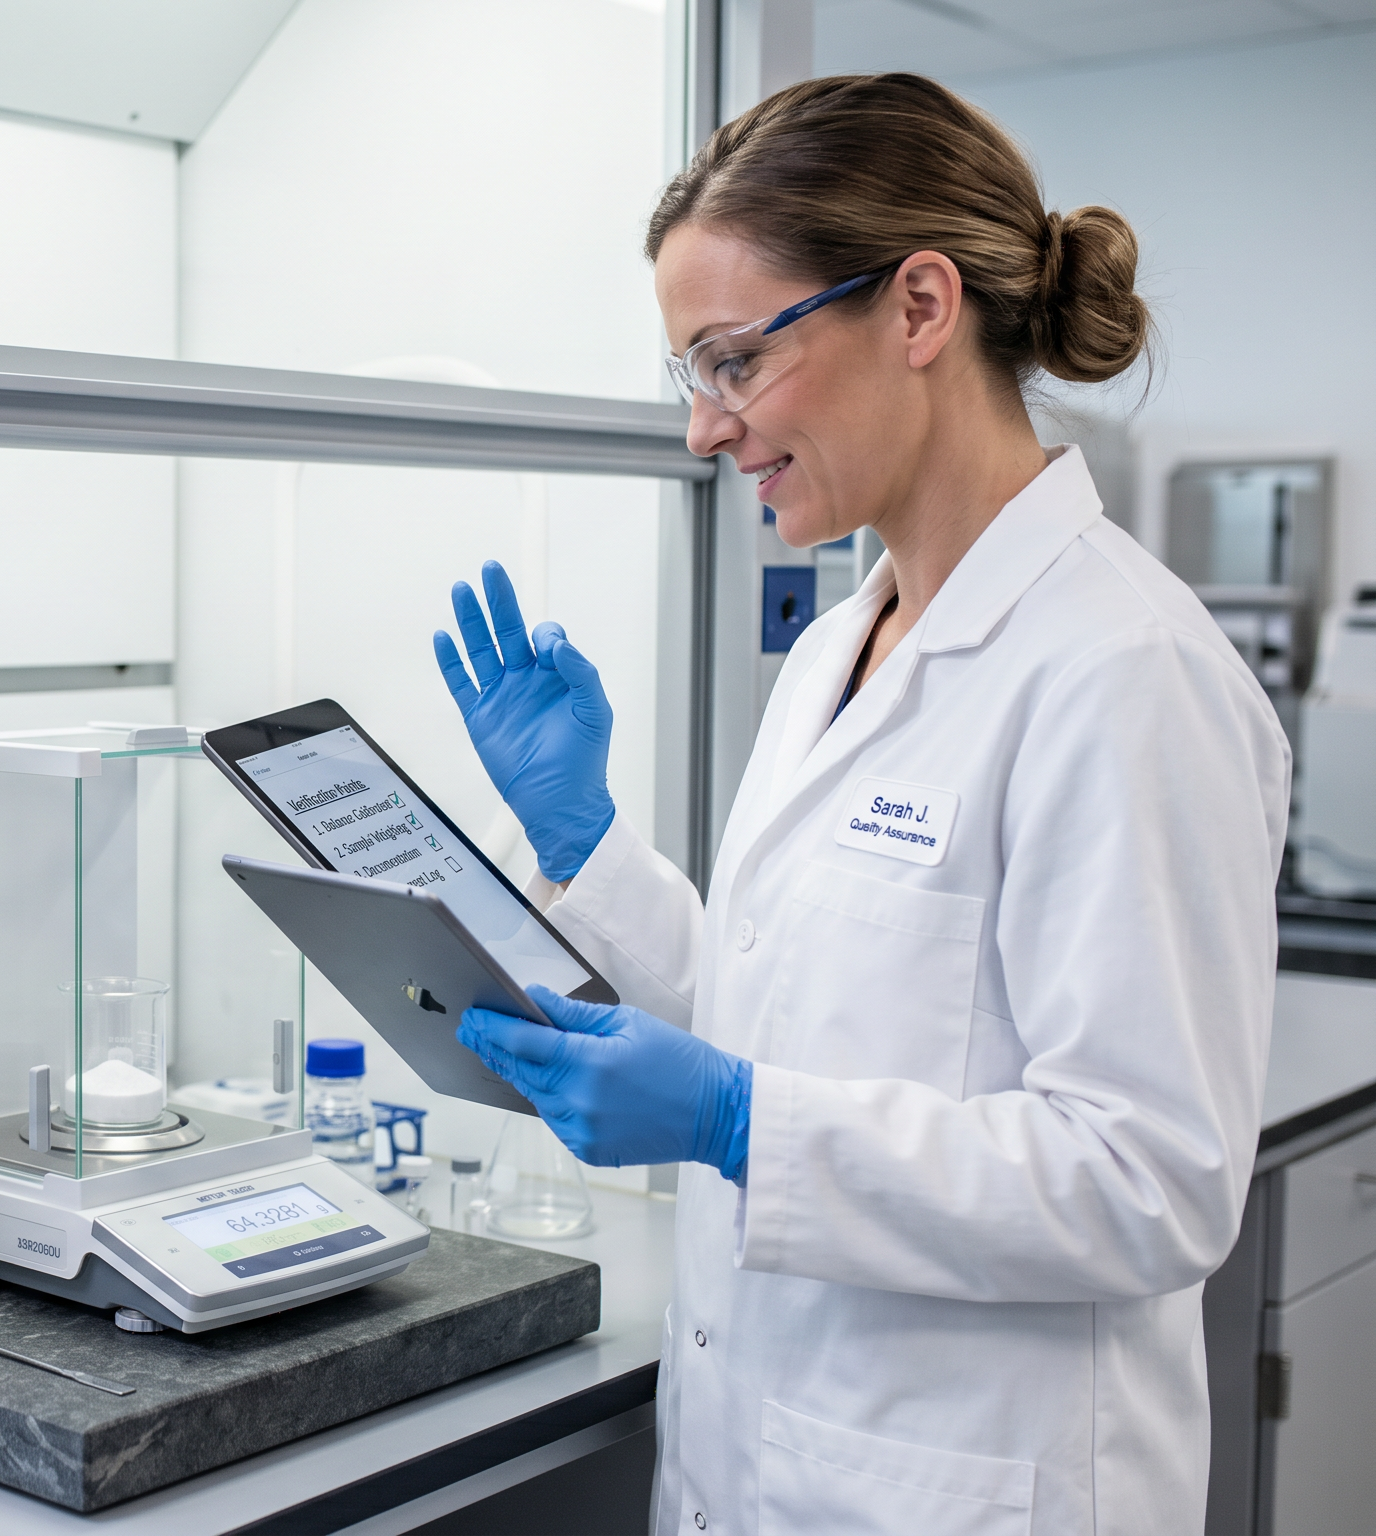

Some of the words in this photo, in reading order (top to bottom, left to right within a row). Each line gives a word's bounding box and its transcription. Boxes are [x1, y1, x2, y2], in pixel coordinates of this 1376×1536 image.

[870, 796, 913, 820] Sarah
[915, 805, 929, 824] J.
[882, 825, 936, 847] Assurance
[225, 1202, 310, 1233] 64.3281
